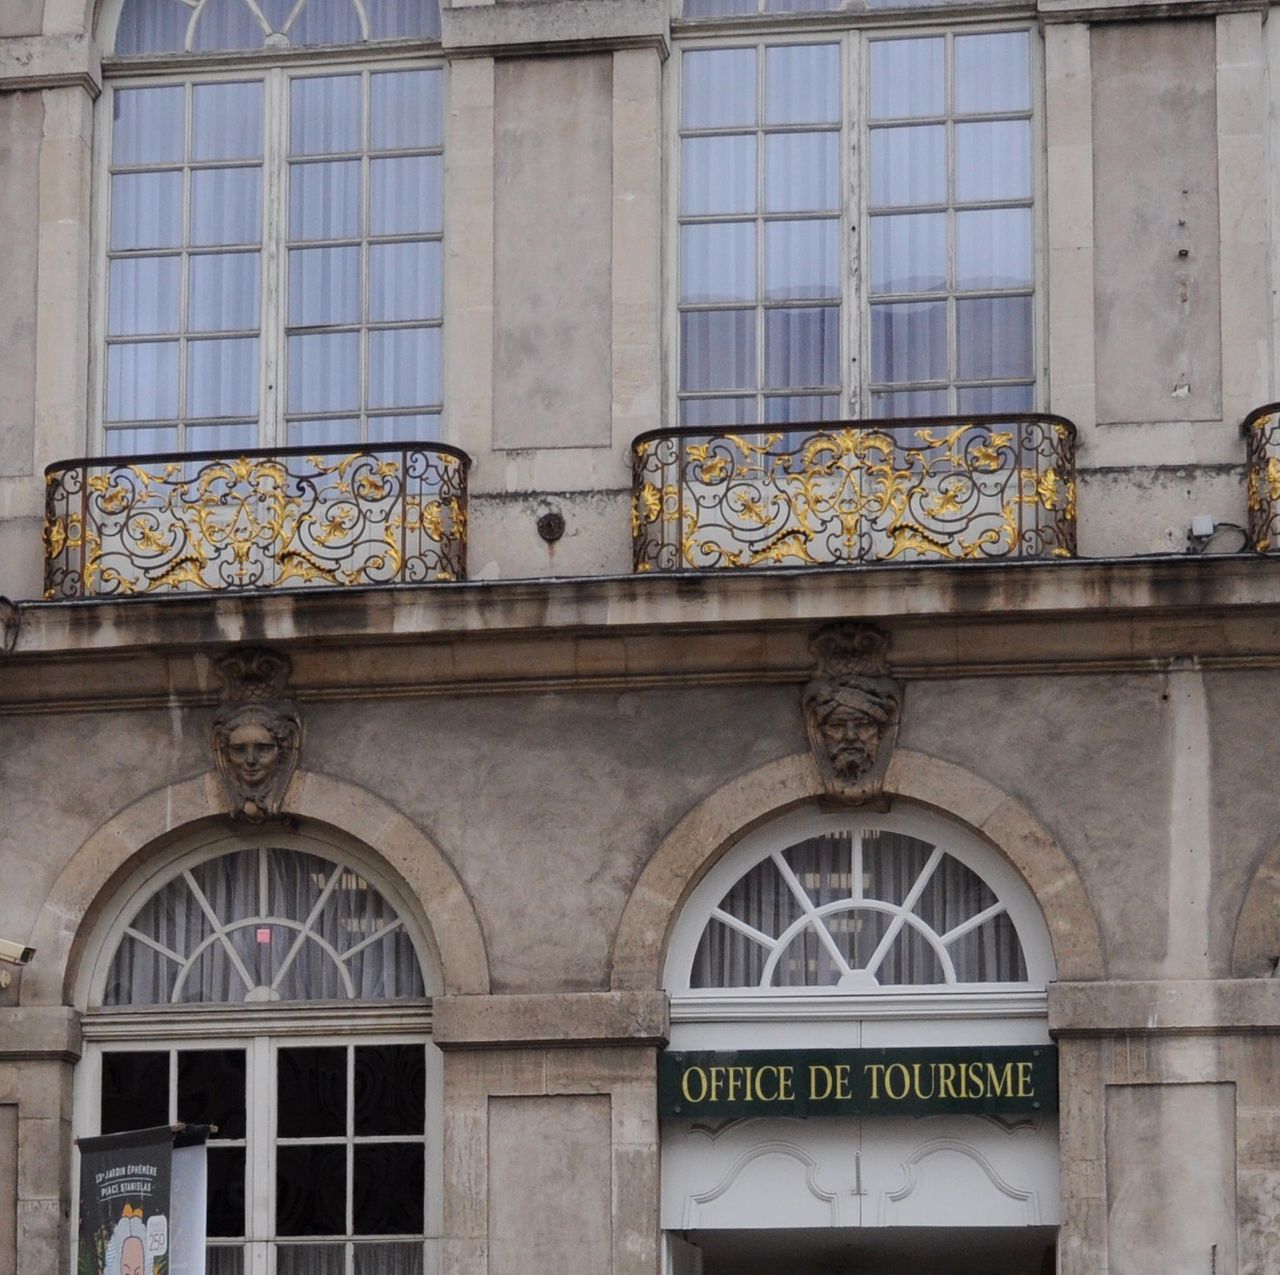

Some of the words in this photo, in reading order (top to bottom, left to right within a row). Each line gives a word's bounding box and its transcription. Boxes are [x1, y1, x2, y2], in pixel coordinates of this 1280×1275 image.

[681, 1065, 795, 1103] OFFICE
[808, 1064, 852, 1100] DE
[863, 1062, 1035, 1100] TOURISME
[120, 1181, 151, 1193] STANISLAS
